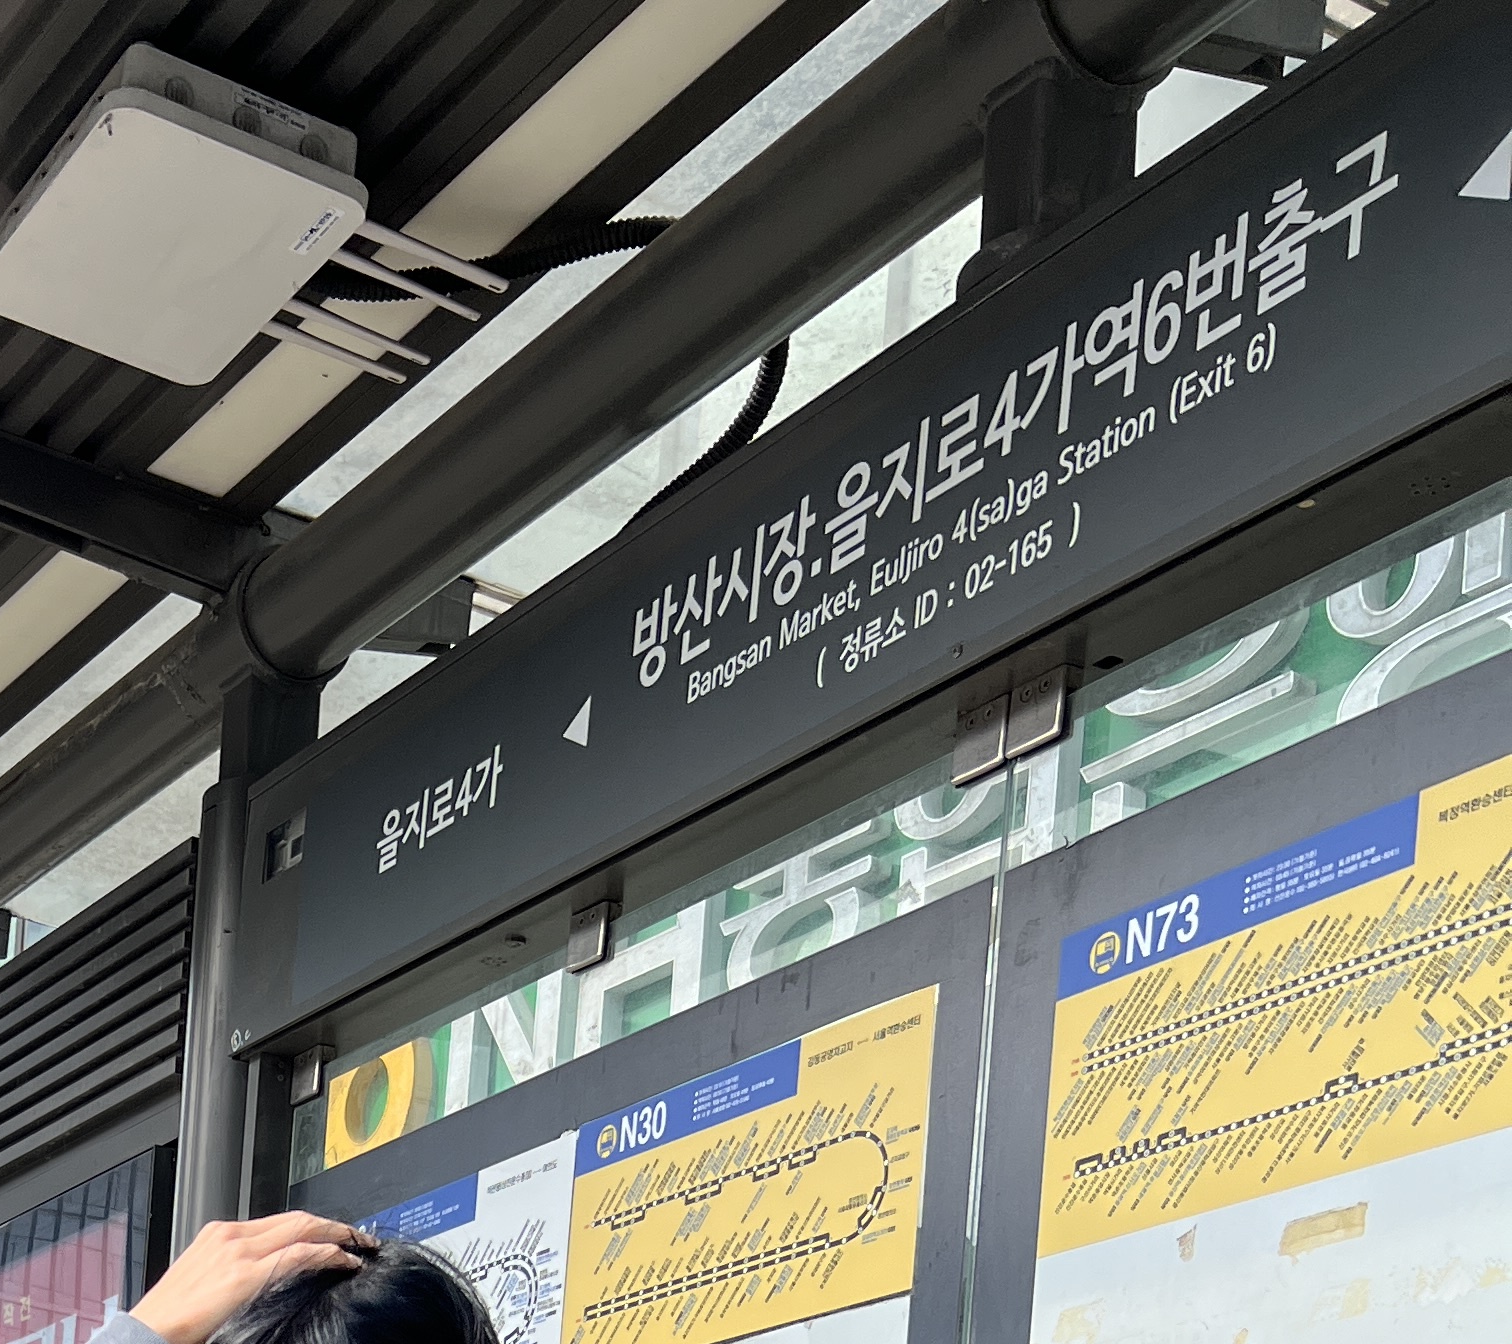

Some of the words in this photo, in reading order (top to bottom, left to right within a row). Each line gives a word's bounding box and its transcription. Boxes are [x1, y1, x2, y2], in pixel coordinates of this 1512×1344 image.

[632, 130, 1400, 688] 방산시장.을지로4가역6번출구
[687, 633, 772, 704] Bangsan
[779, 579, 862, 651] Market,
[870, 533, 944, 594] Euljiro
[951, 468, 1049, 545] 4(sa)ga
[1056, 406, 1157, 485] Station
[1168, 353, 1236, 425] (Exit
[1245, 321, 1278, 374] 6)
[839, 609, 907, 674] 정류소
[913, 587, 938, 629] ID
[963, 523, 1054, 600] 02-165
[375, 743, 505, 875] 을지로4가
[1124, 892, 1201, 965] N73
[618, 1101, 667, 1149] N30
